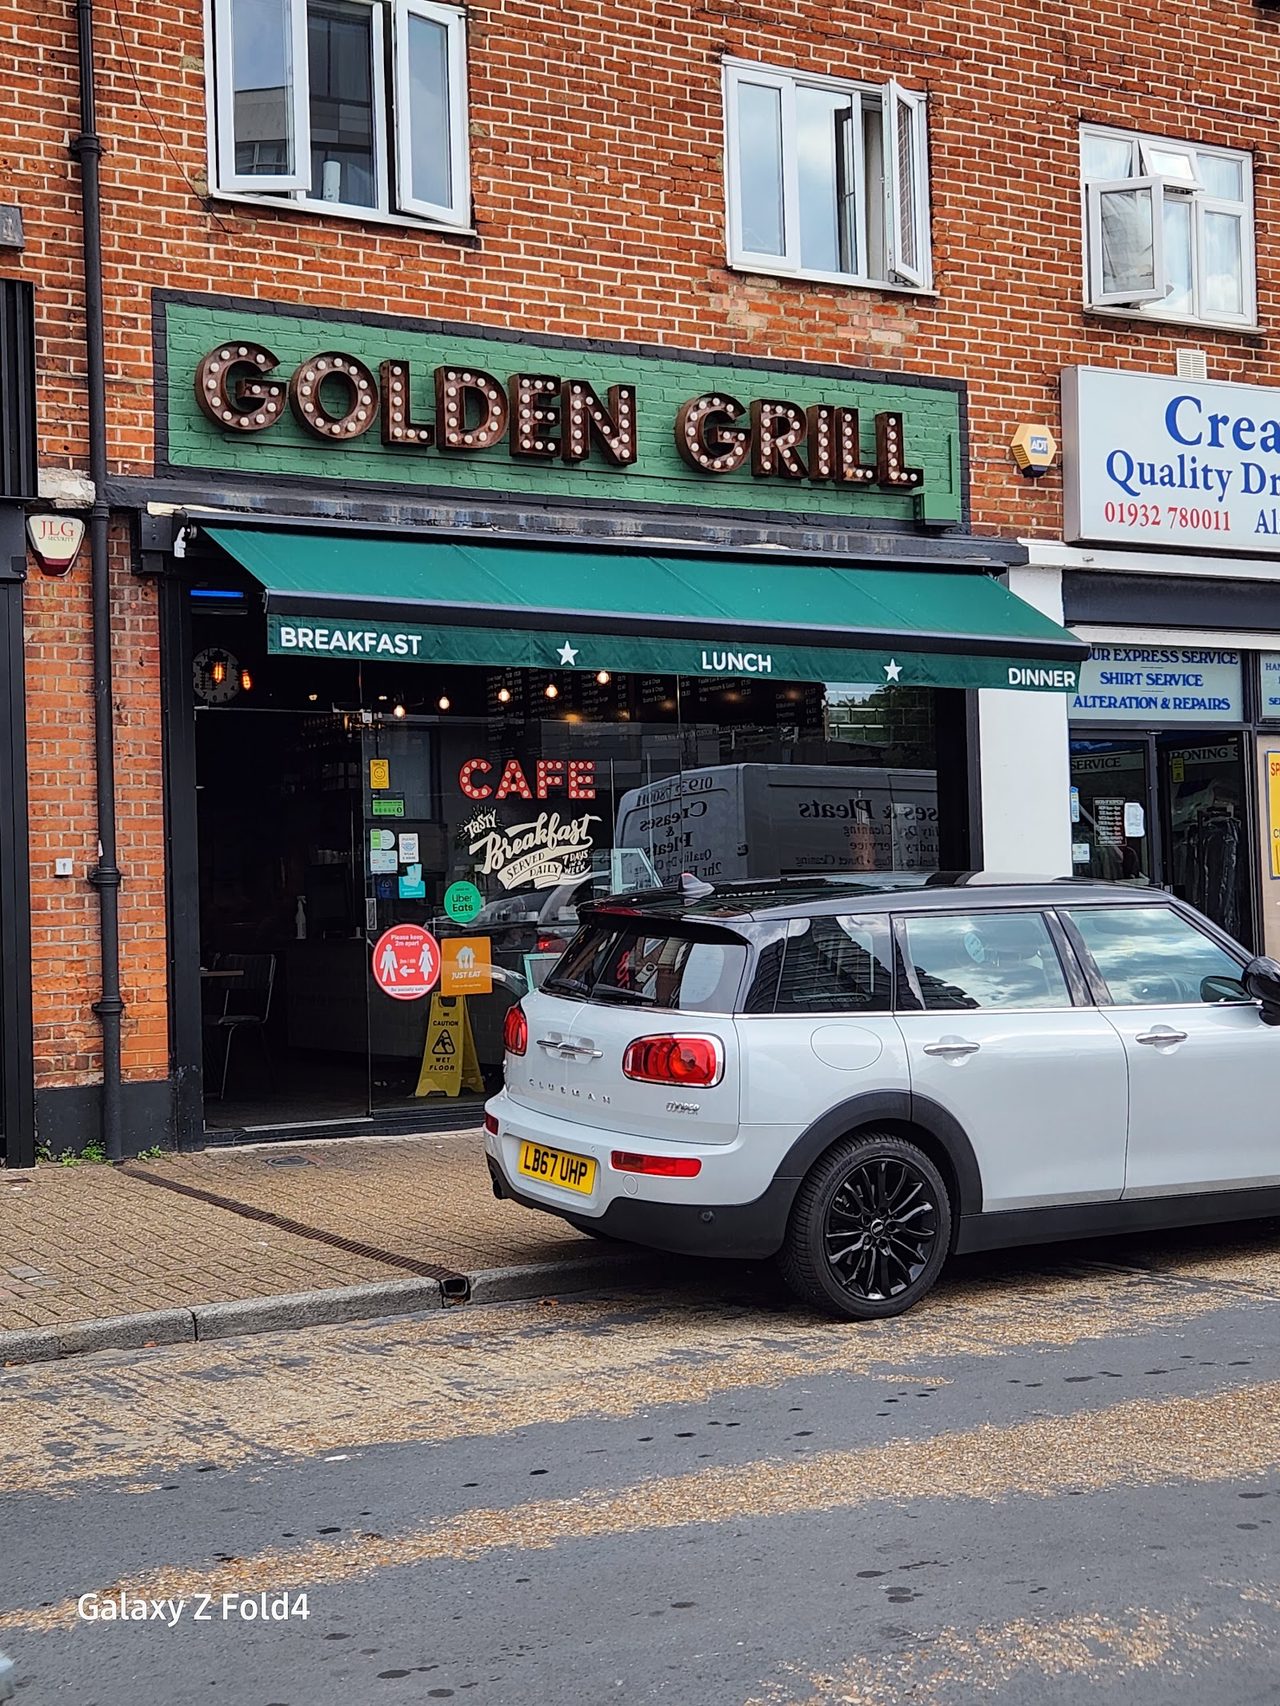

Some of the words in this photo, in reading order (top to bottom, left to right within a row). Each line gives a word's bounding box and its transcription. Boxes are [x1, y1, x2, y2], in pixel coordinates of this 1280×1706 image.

[195, 340, 638, 466] GOLDEN
[675, 392, 924, 488] GRILL
[1030, 437, 1048, 452] ADT
[1106, 449, 1233, 502] Quality
[1104, 501, 1162, 527] 01932
[1167, 507, 1231, 532] 780011
[1254, 508, 1280, 535] Al
[39, 520, 74, 539] JLG
[280, 626, 422, 656] BREAKFAST
[701, 651, 772, 673] LUNCH
[1114, 649, 1179, 663] EXPRESS
[1181, 651, 1238, 665] SERVICE
[1008, 667, 1076, 688] DINNER
[1100, 671, 1143, 686] SHIRT
[1146, 673, 1203, 687] SERVICE
[1073, 695, 1158, 710] ALTERATION
[1160, 697, 1170, 710] &
[1173, 697, 1231, 711] REPAIRS
[1071, 758, 1121, 770] SERVICE
[459, 758, 596, 799] CAFE
[469, 812, 602, 874] Breakfast
[570, 850, 588, 862] DAYS
[507, 852, 545, 880] SERVED
[529, 865, 560, 877] DAILY
[564, 862, 586, 875] WEEK
[452, 893, 473, 903] Uber
[452, 903, 474, 912] Eats
[410, 934, 424, 942] keep
[451, 971, 467, 980] JUST
[523, 1145, 558, 1177] LB67
[560, 1156, 588, 1186] UHP
